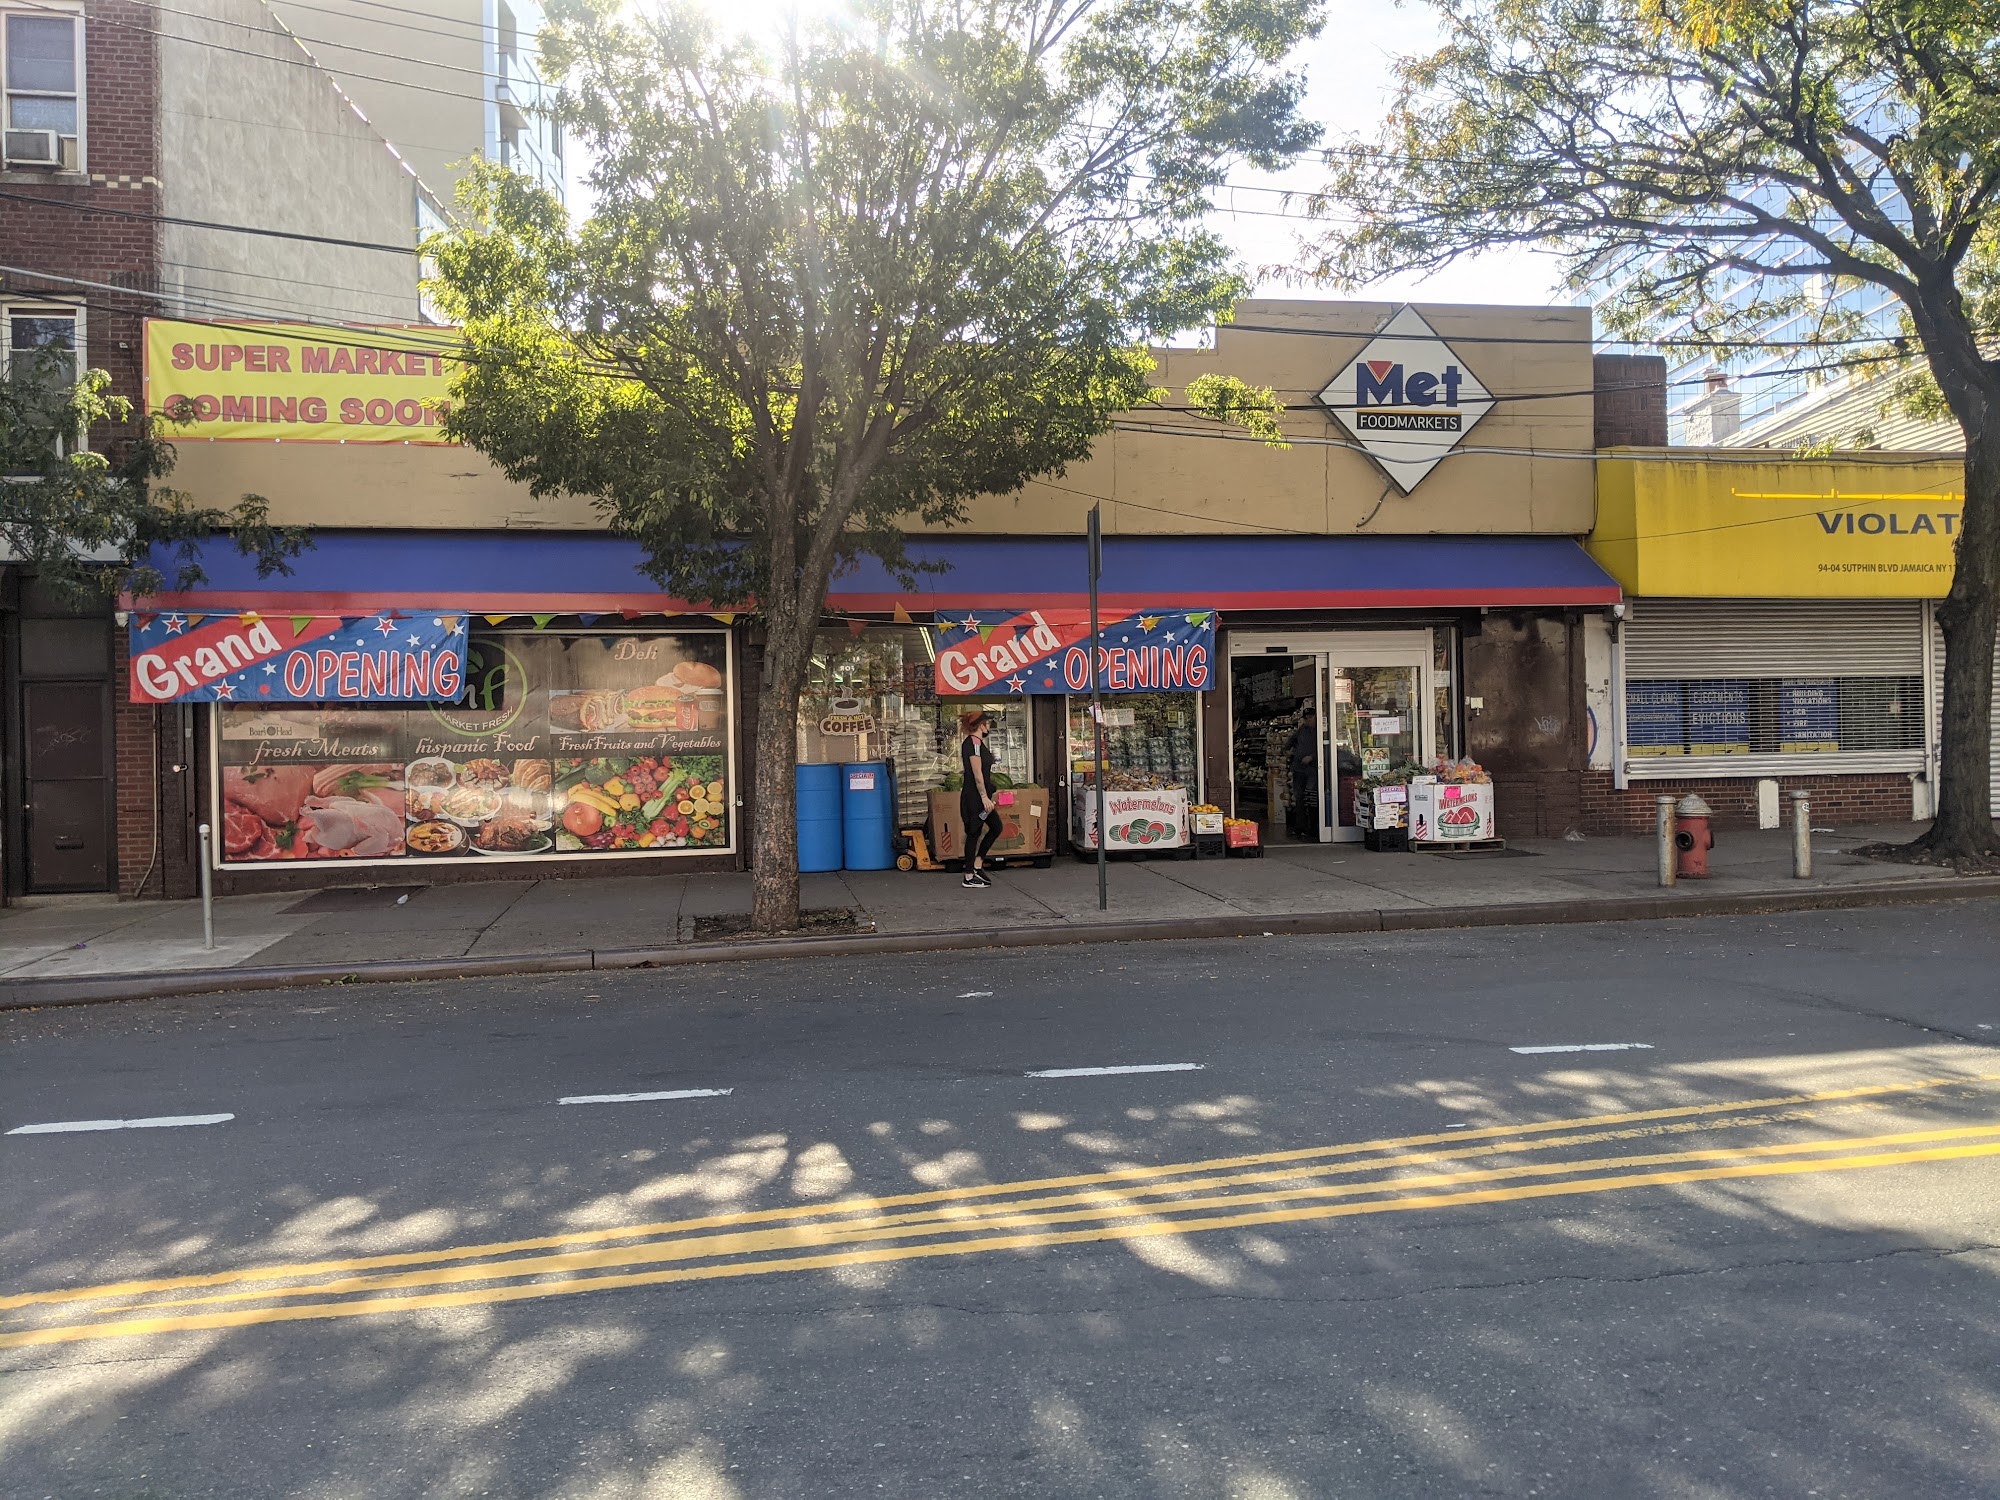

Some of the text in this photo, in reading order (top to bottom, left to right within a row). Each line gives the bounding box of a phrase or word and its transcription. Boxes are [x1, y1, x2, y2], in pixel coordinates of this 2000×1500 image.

[171, 343, 444, 376] SUPER MARKET
[1357, 361, 1462, 407] Met
[164, 394, 327, 424] COMING
[1360, 415, 1458, 430] FOODMARKETS
[1816, 513, 1960, 535] VIOLAT
[1818, 564, 1840, 573] 94-04
[1842, 563, 1876, 573] SUTPHIN
[1878, 564, 1899, 573] BLVD
[1900, 564, 1935, 573] JAMAICA
[1936, 564, 1947, 573] NY
[136, 611, 460, 699] Grand OPENING
[614, 637, 658, 661] Deli
[940, 611, 1208, 692] Grand OPENING
[440, 706, 513, 731] MARKET FRESH
[823, 719, 872, 732] COFFEE
[1693, 712, 1745, 724] EVICTIONS
[276, 727, 292, 736] Head
[493, 731, 540, 752] Food
[308, 738, 379, 757] Meats
[559, 734, 722, 751] Fresh Fruits and Vegetables
